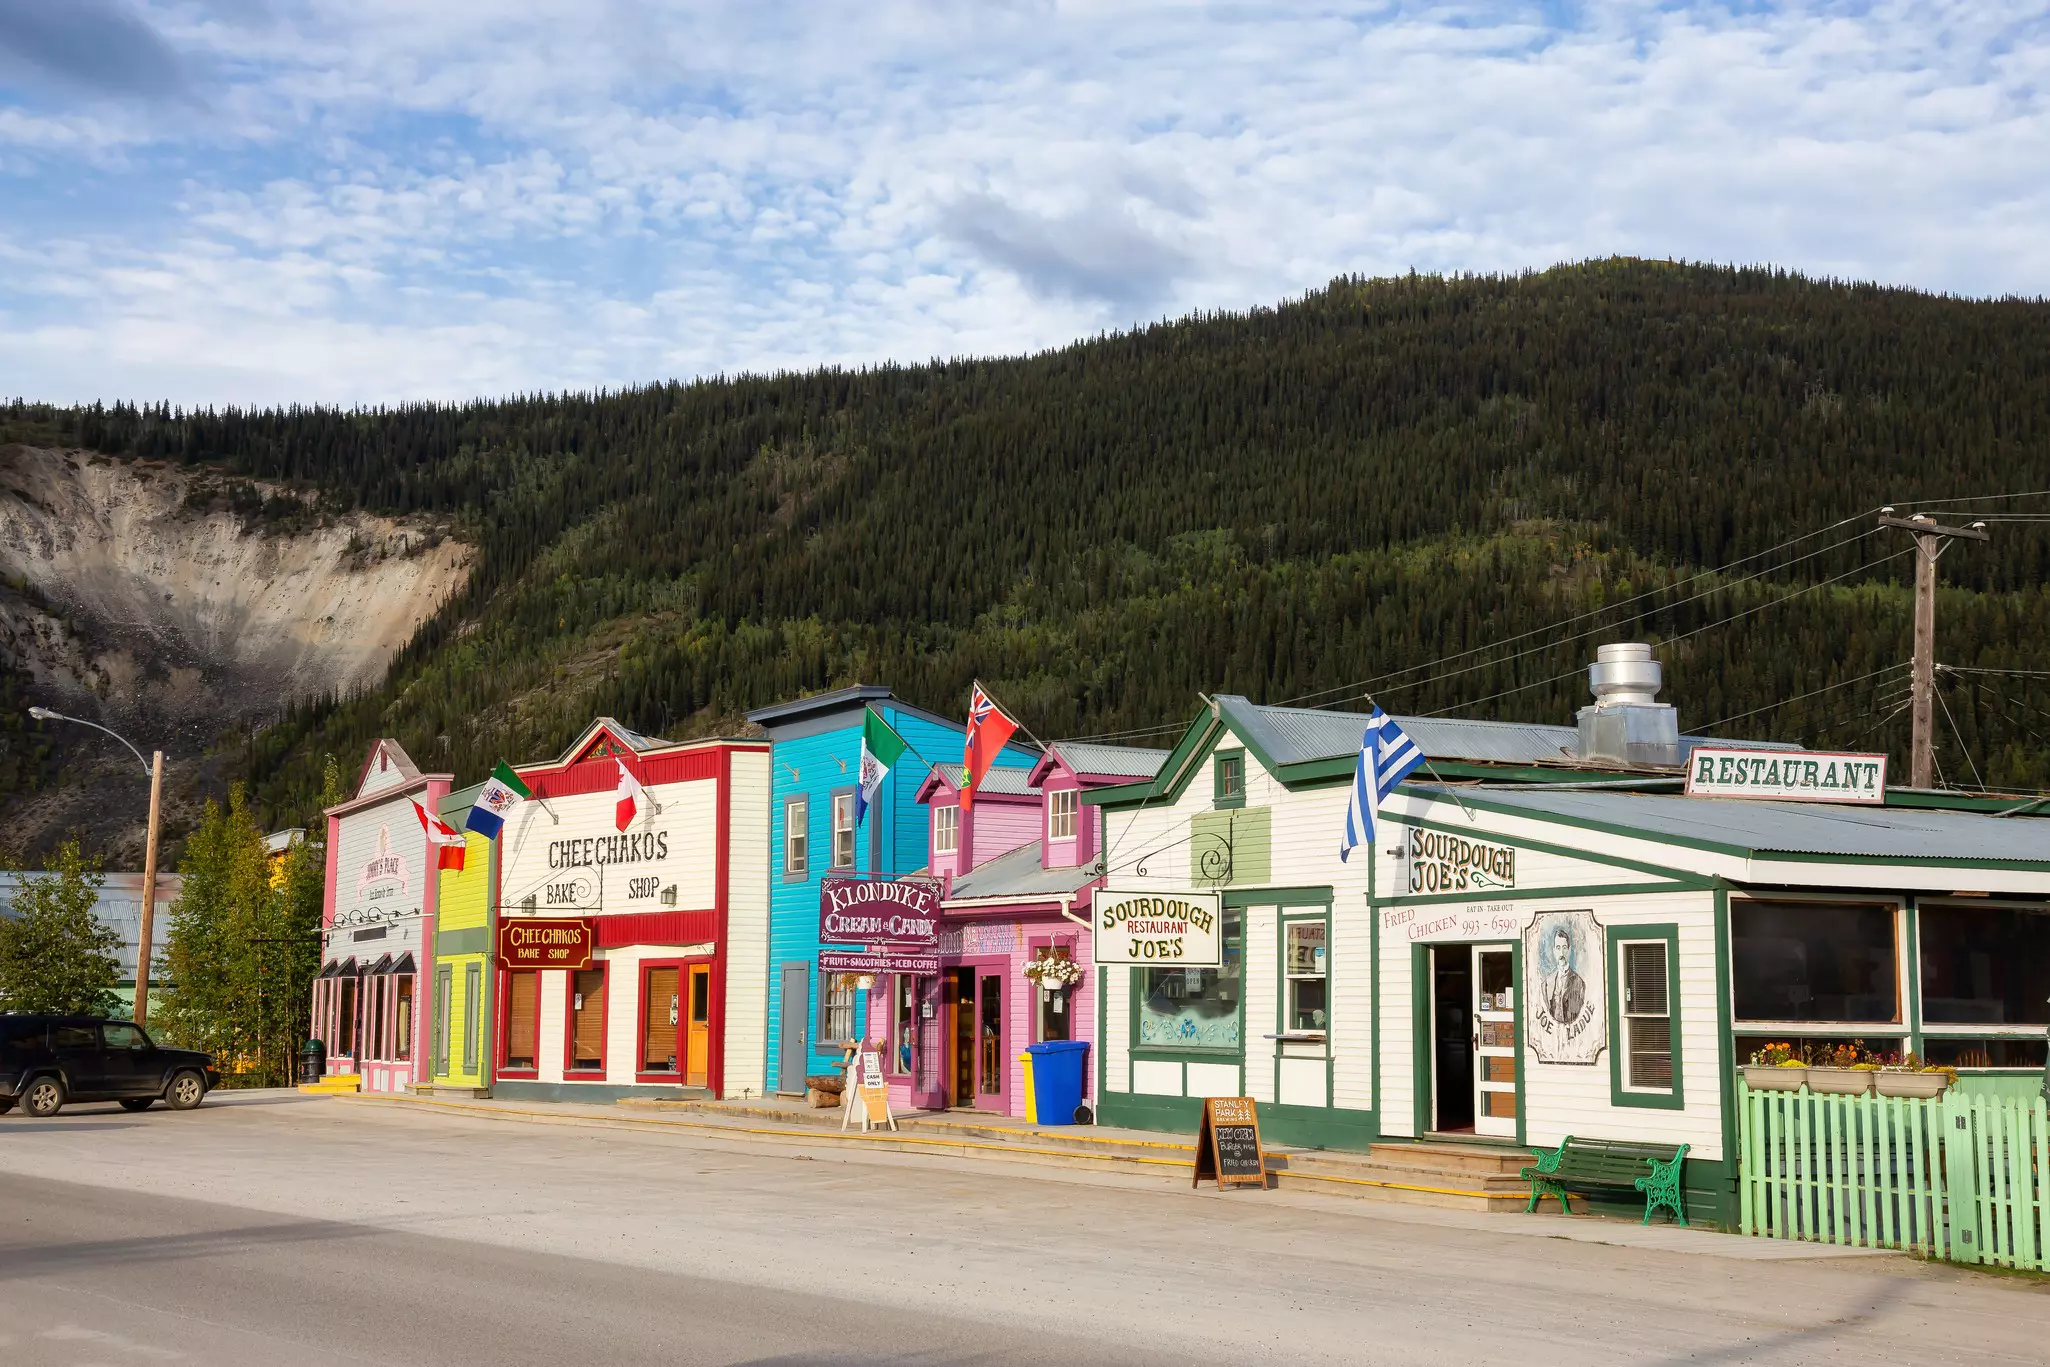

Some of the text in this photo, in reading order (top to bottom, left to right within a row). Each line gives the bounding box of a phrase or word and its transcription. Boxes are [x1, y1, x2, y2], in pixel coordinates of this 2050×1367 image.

[1695, 757, 1879, 790] RESTAURANT
[549, 831, 668, 869] CHEECHAKOS
[1411, 828, 1513, 880] SOURDOUGH
[1412, 861, 1468, 893] JOE'S
[546, 877, 660, 904] BAKE SHOP
[827, 882, 931, 915] KLONDYKE
[1103, 898, 1213, 934] SOURDOUGH
[1383, 908, 1415, 929] FRIED
[1466, 905, 1476, 913] EAT
[1487, 904, 1500, 912] TAKE
[1501, 904, 1514, 912] OUT
[510, 927, 582, 946] CHEECHAKOS
[825, 914, 882, 933] CREAM
[888, 914, 937, 937] CANDY
[1128, 920, 1188, 934] RESTAURANT
[1408, 915, 1457, 940] CHICKEN
[1462, 920, 1480, 936] 993
[1492, 914, 1517, 935] 6590
[518, 948, 570, 959] BAKE SHOP
[1129, 937, 1183, 958] JOE'S
[823, 957, 937, 969] FRUIT SMOOTHIES ICED COFFEE
[1536, 1000, 1596, 1040] JOE LADUE
[1214, 1100, 1250, 1108] STANLEY
